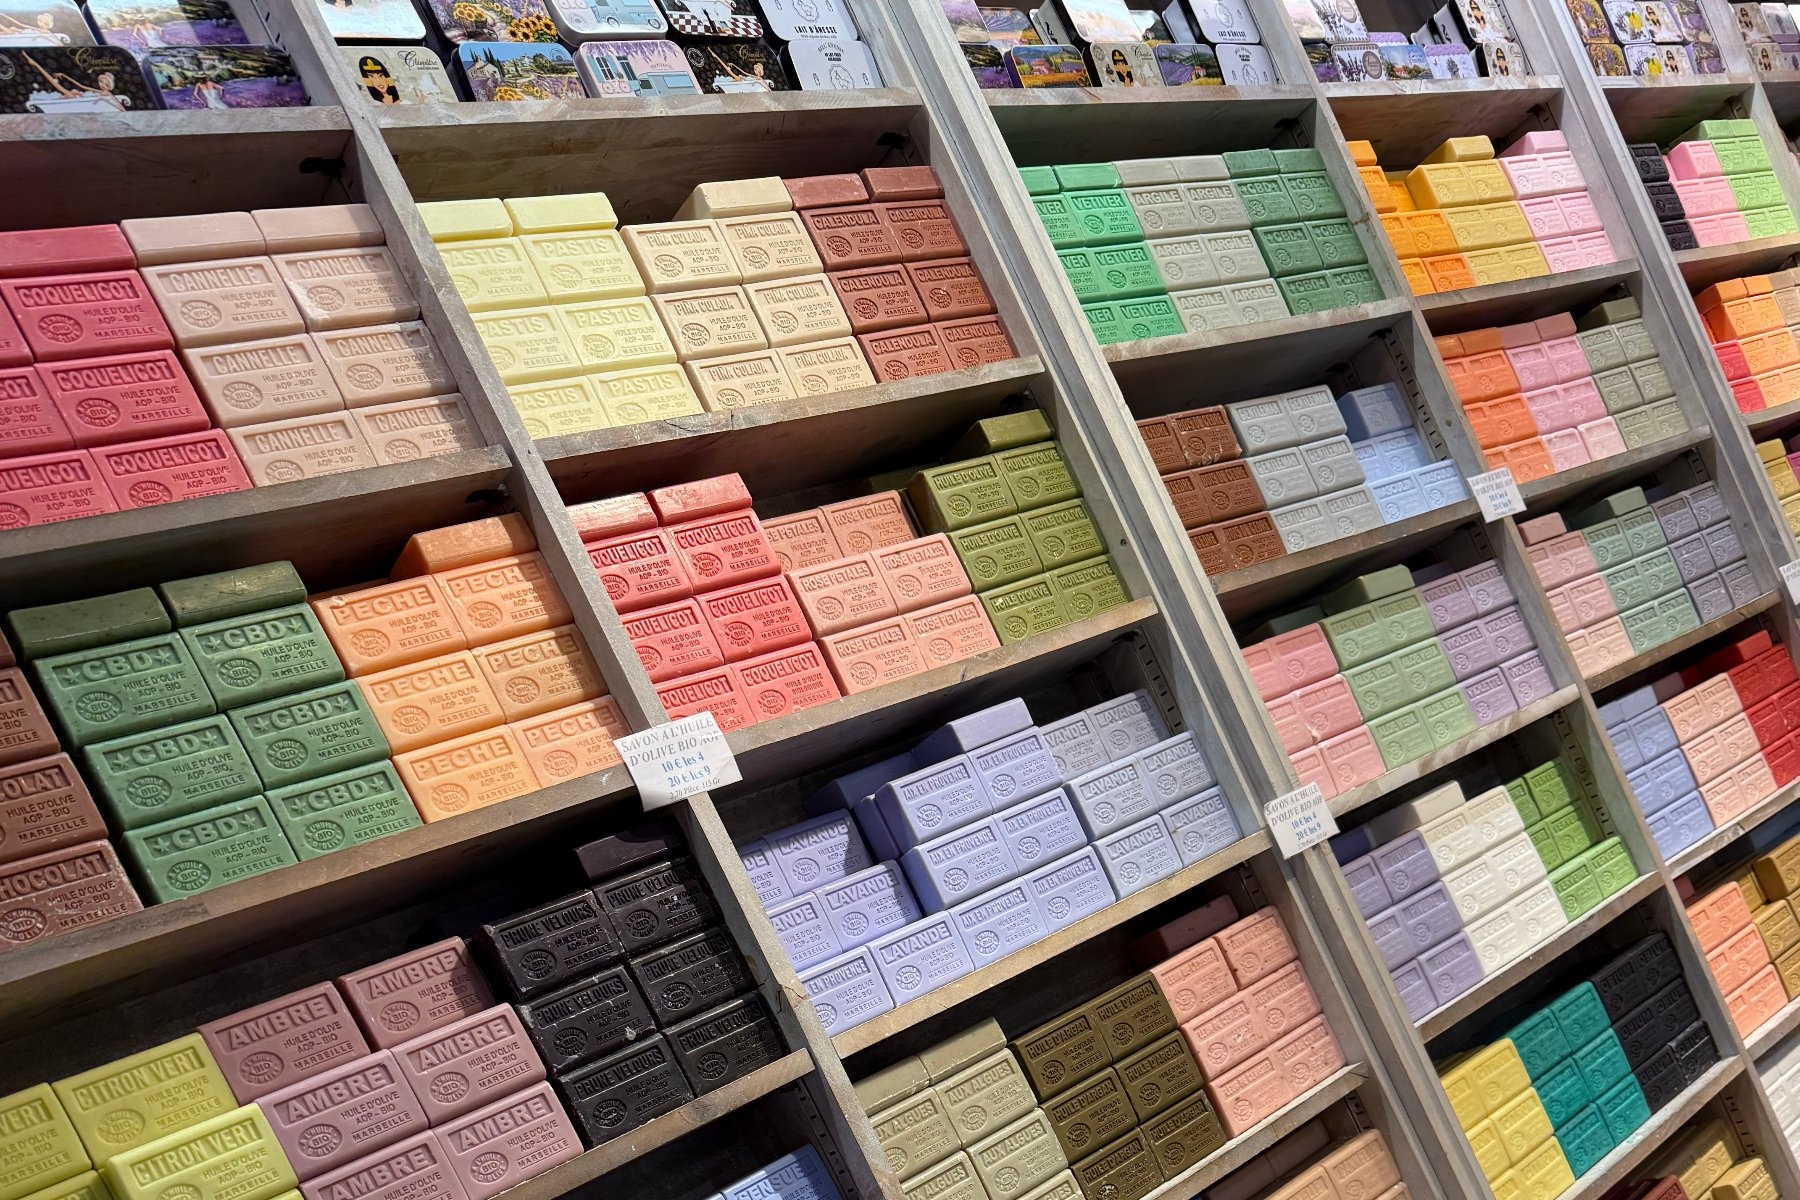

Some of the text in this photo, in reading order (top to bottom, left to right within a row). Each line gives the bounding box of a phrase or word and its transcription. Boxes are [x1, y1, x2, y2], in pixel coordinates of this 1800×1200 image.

[1071, 194, 1122, 210] VETIVER
[1136, 189, 1179, 206] ARGILE
[1189, 185, 1231, 201] ARGILE
[815, 211, 877, 230] CALENDULA
[541, 237, 611, 259] PASTIS
[169, 266, 258, 291] CANNELLE
[19, 281, 135, 307] COQUELICOT
[94, 326, 156, 338] MARSEILLE
[57, 360, 172, 391] COQUELICOT
[934, 474, 962, 491] HUILE
[676, 519, 753, 548] COQUELICOT
[802, 577, 830, 593] ROSE
[82, 651, 153, 681] CBD
[129, 731, 201, 766] CBD
[622, 731, 659, 752] SAVON
[671, 717, 714, 737] L'HUILE
[630, 731, 719, 767] D'OLIVE BIO AOP
[661, 761, 674, 773] 10
[683, 756, 697, 766] les
[668, 776, 680, 788] 20
[690, 770, 703, 780] les
[704, 765, 711, 776] 9
[1079, 767, 1137, 798] LAVANDE
[1300, 800, 1312, 813] BIO
[0, 853, 103, 898] HOCOLAT
[826, 873, 897, 910] LAVANDE
[501, 902, 597, 949] PRUNE VELOURS
[227, 998, 331, 1050] AMBRE
[971, 1061, 1012, 1094] ALGUES
[286, 1066, 390, 1122] AMBRE
[134, 1119, 260, 1185] CITRON VERT
